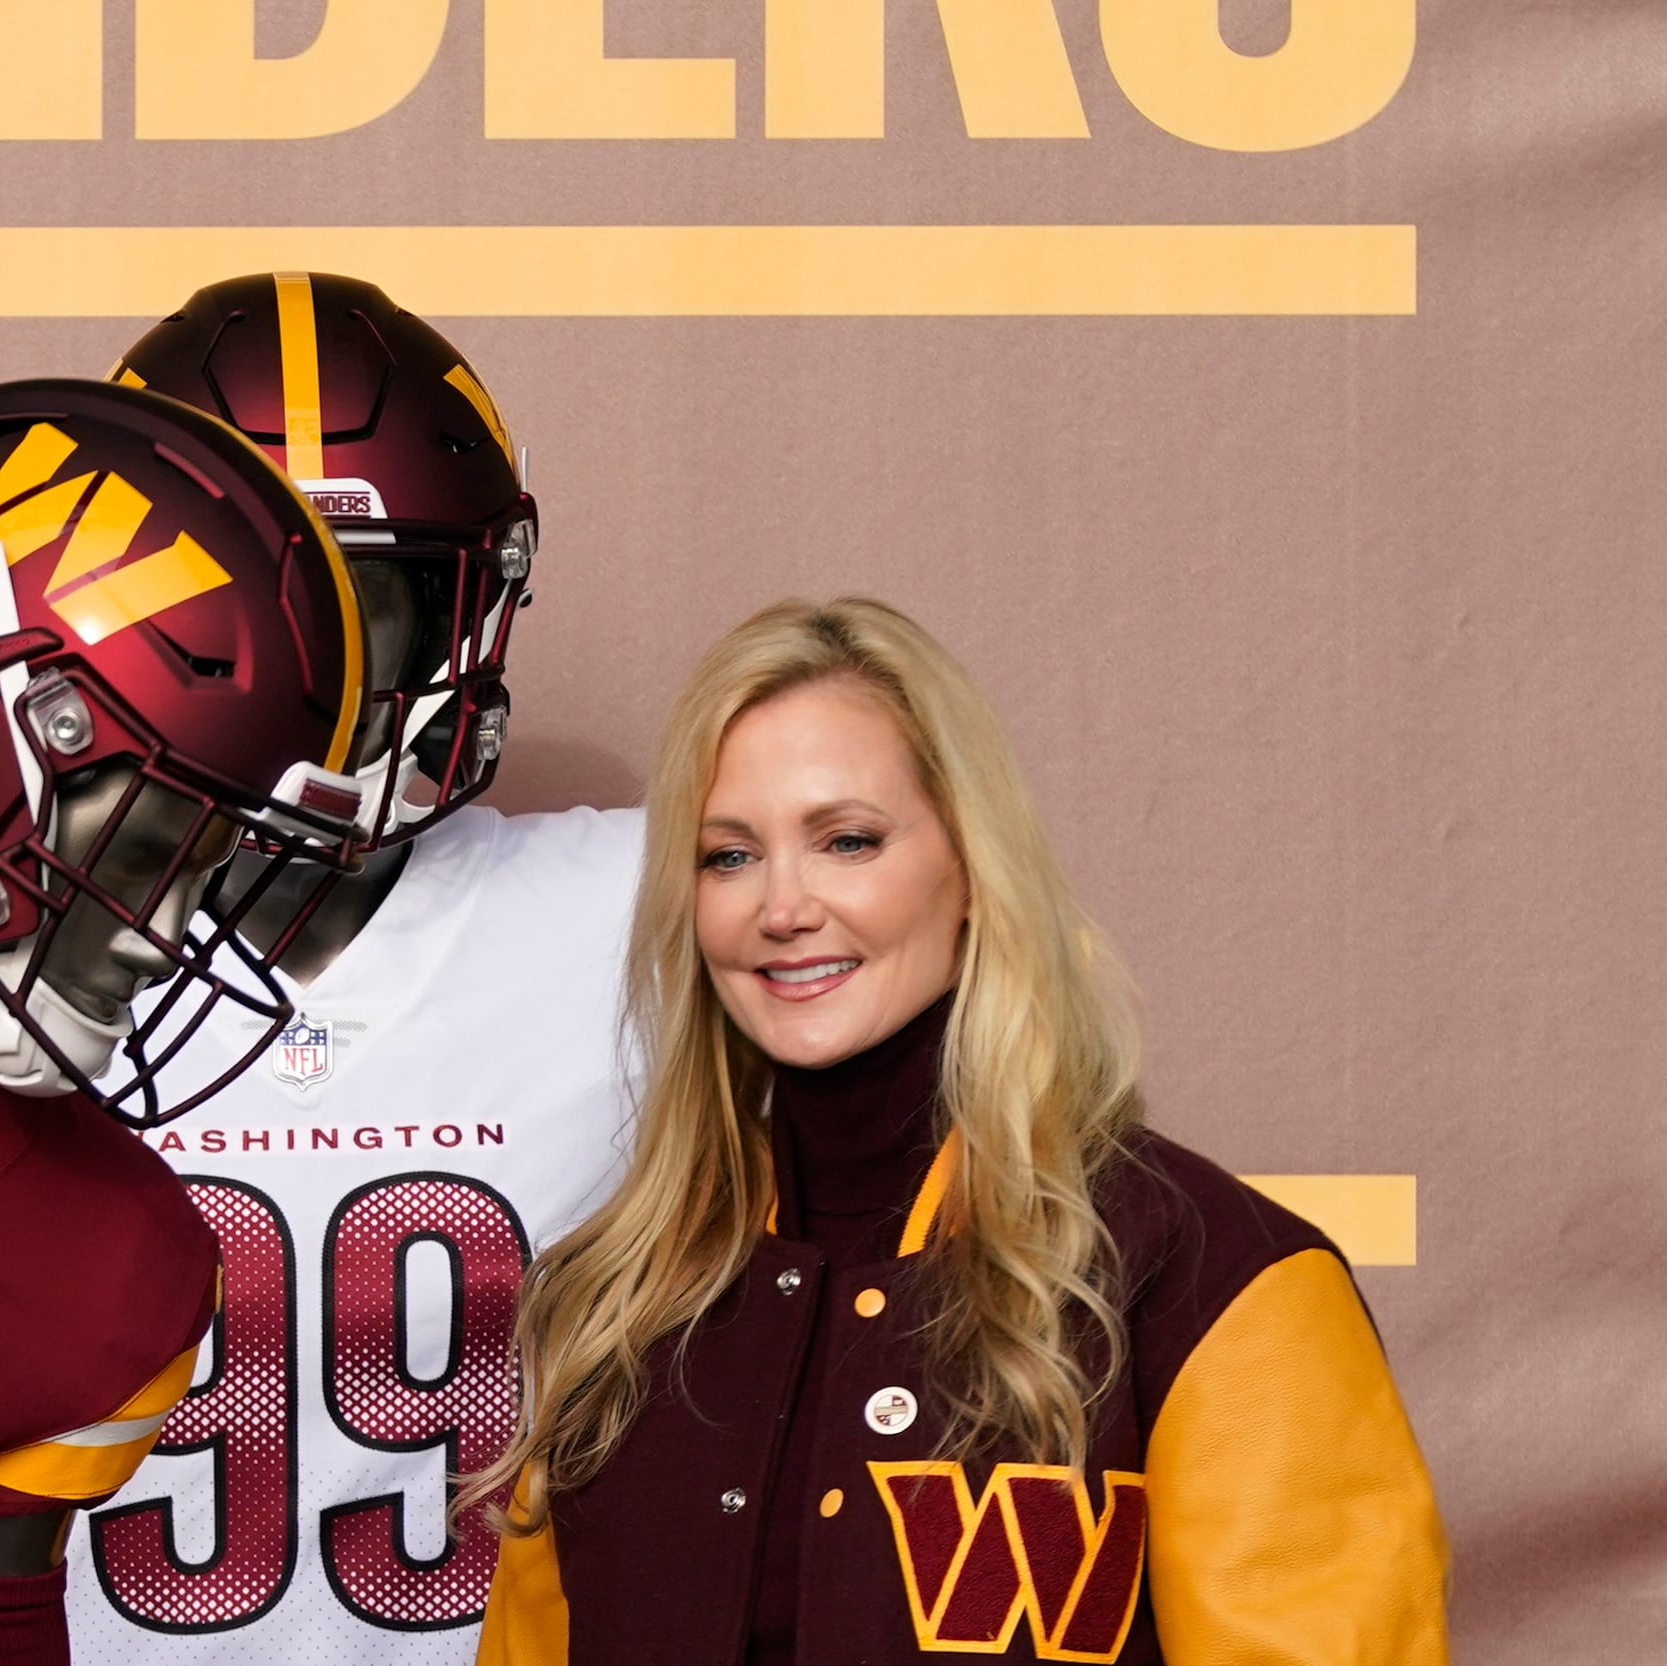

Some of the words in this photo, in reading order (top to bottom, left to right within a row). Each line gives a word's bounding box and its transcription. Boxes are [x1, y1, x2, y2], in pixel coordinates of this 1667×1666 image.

[307, 495, 371, 513] NDERS
[283, 1047, 323, 1076] NFL
[136, 1122, 506, 1154] ASHINGTON
[89, 1170, 533, 1634] 99
